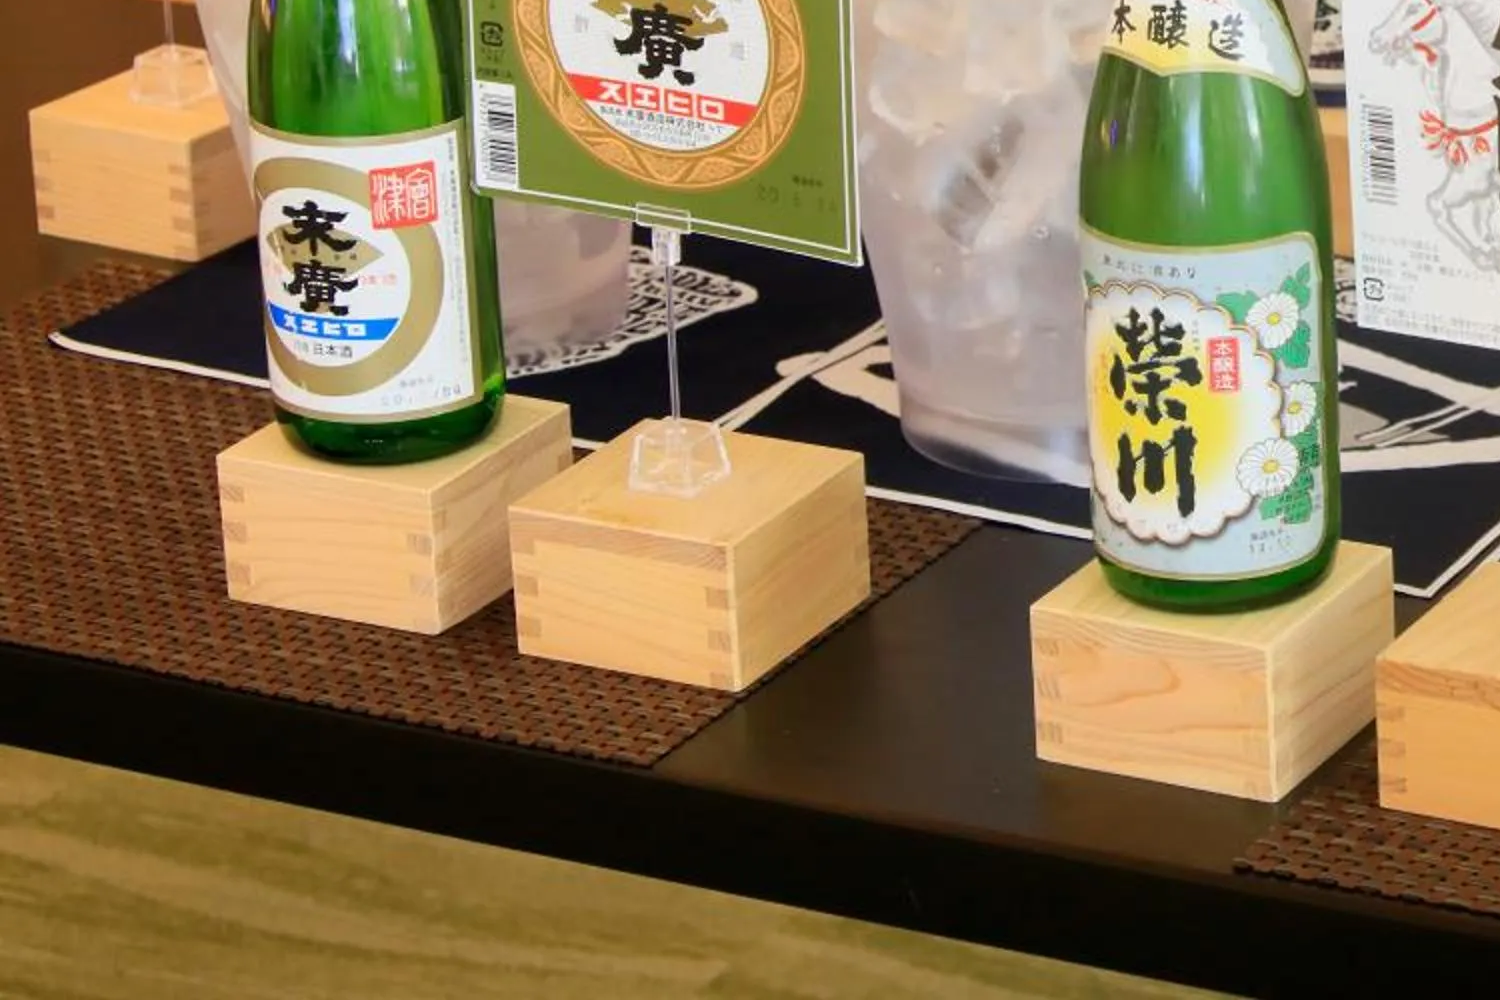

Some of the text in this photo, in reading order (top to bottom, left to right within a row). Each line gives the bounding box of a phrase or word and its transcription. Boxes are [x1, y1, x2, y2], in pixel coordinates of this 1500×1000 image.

[599, 81, 725, 122] スエヒロ
[282, 200, 358, 316] 末廣
[283, 313, 367, 337] スエヒロ
